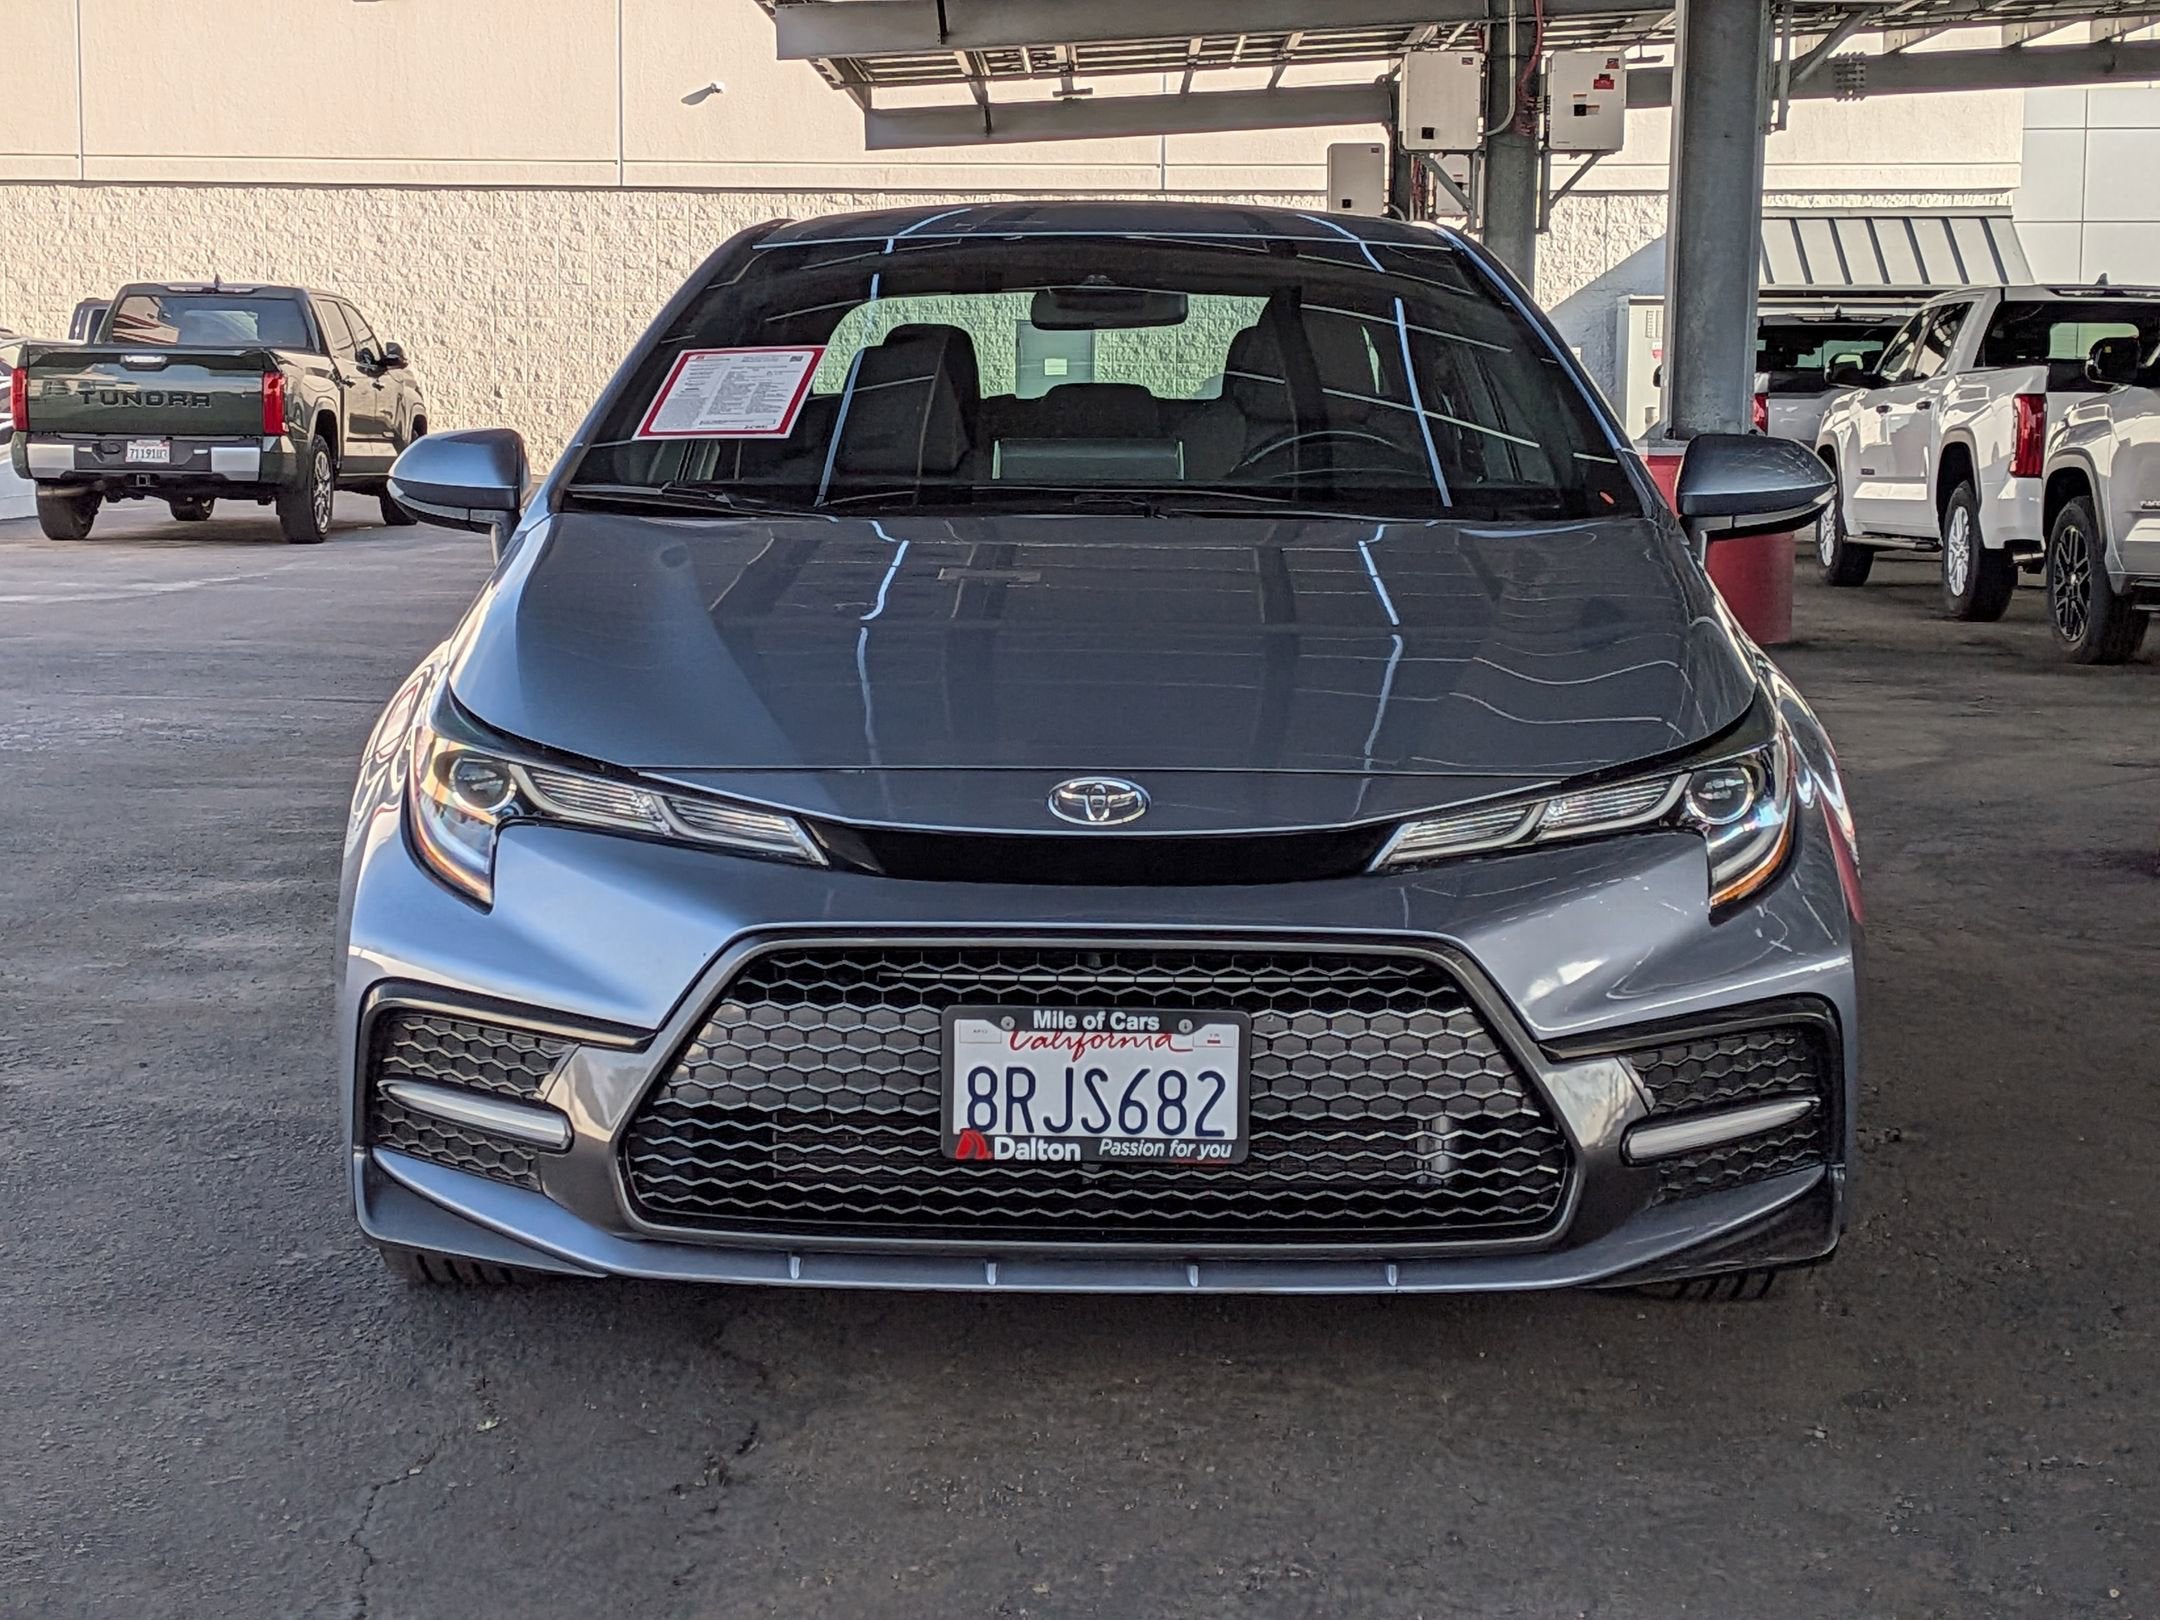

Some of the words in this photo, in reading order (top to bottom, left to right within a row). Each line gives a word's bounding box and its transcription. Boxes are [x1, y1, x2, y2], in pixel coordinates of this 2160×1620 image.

[79, 390, 211, 408] TUNDRA
[1033, 1010, 1074, 1029] Mile
[1082, 1010, 1106, 1030] of
[1110, 1012, 1160, 1031] Cars
[1010, 1031, 1193, 1062] California
[967, 1066, 1226, 1137] 8RJS682
[993, 1137, 1081, 1161] Dalton
[1099, 1138, 1164, 1157] Passion
[1169, 1139, 1196, 1157] for
[1197, 1143, 1232, 1161] you
